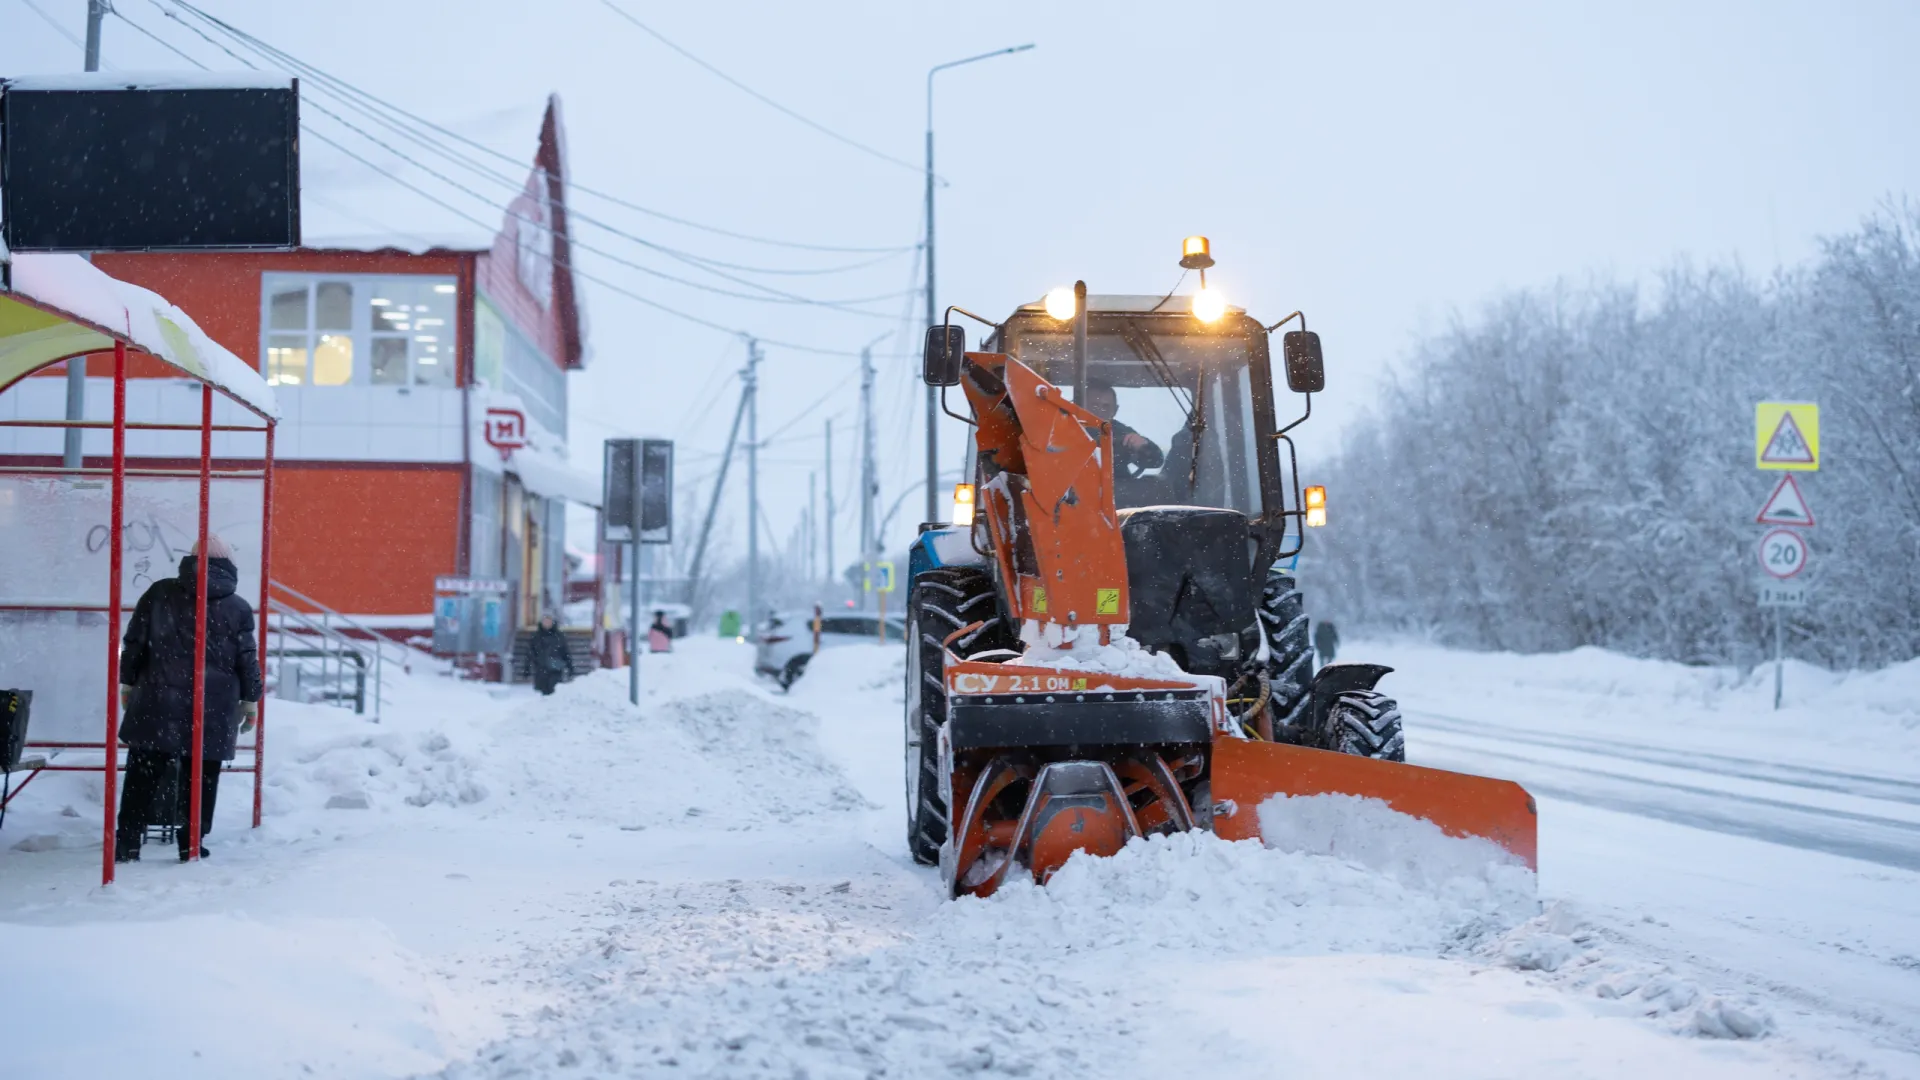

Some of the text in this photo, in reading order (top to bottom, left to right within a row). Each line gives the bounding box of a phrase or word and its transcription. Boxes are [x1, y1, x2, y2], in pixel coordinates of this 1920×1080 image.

[1769, 543, 1797, 565] 20
[955, 673, 999, 692] СУ
[1009, 675, 1041, 691] 2.1
